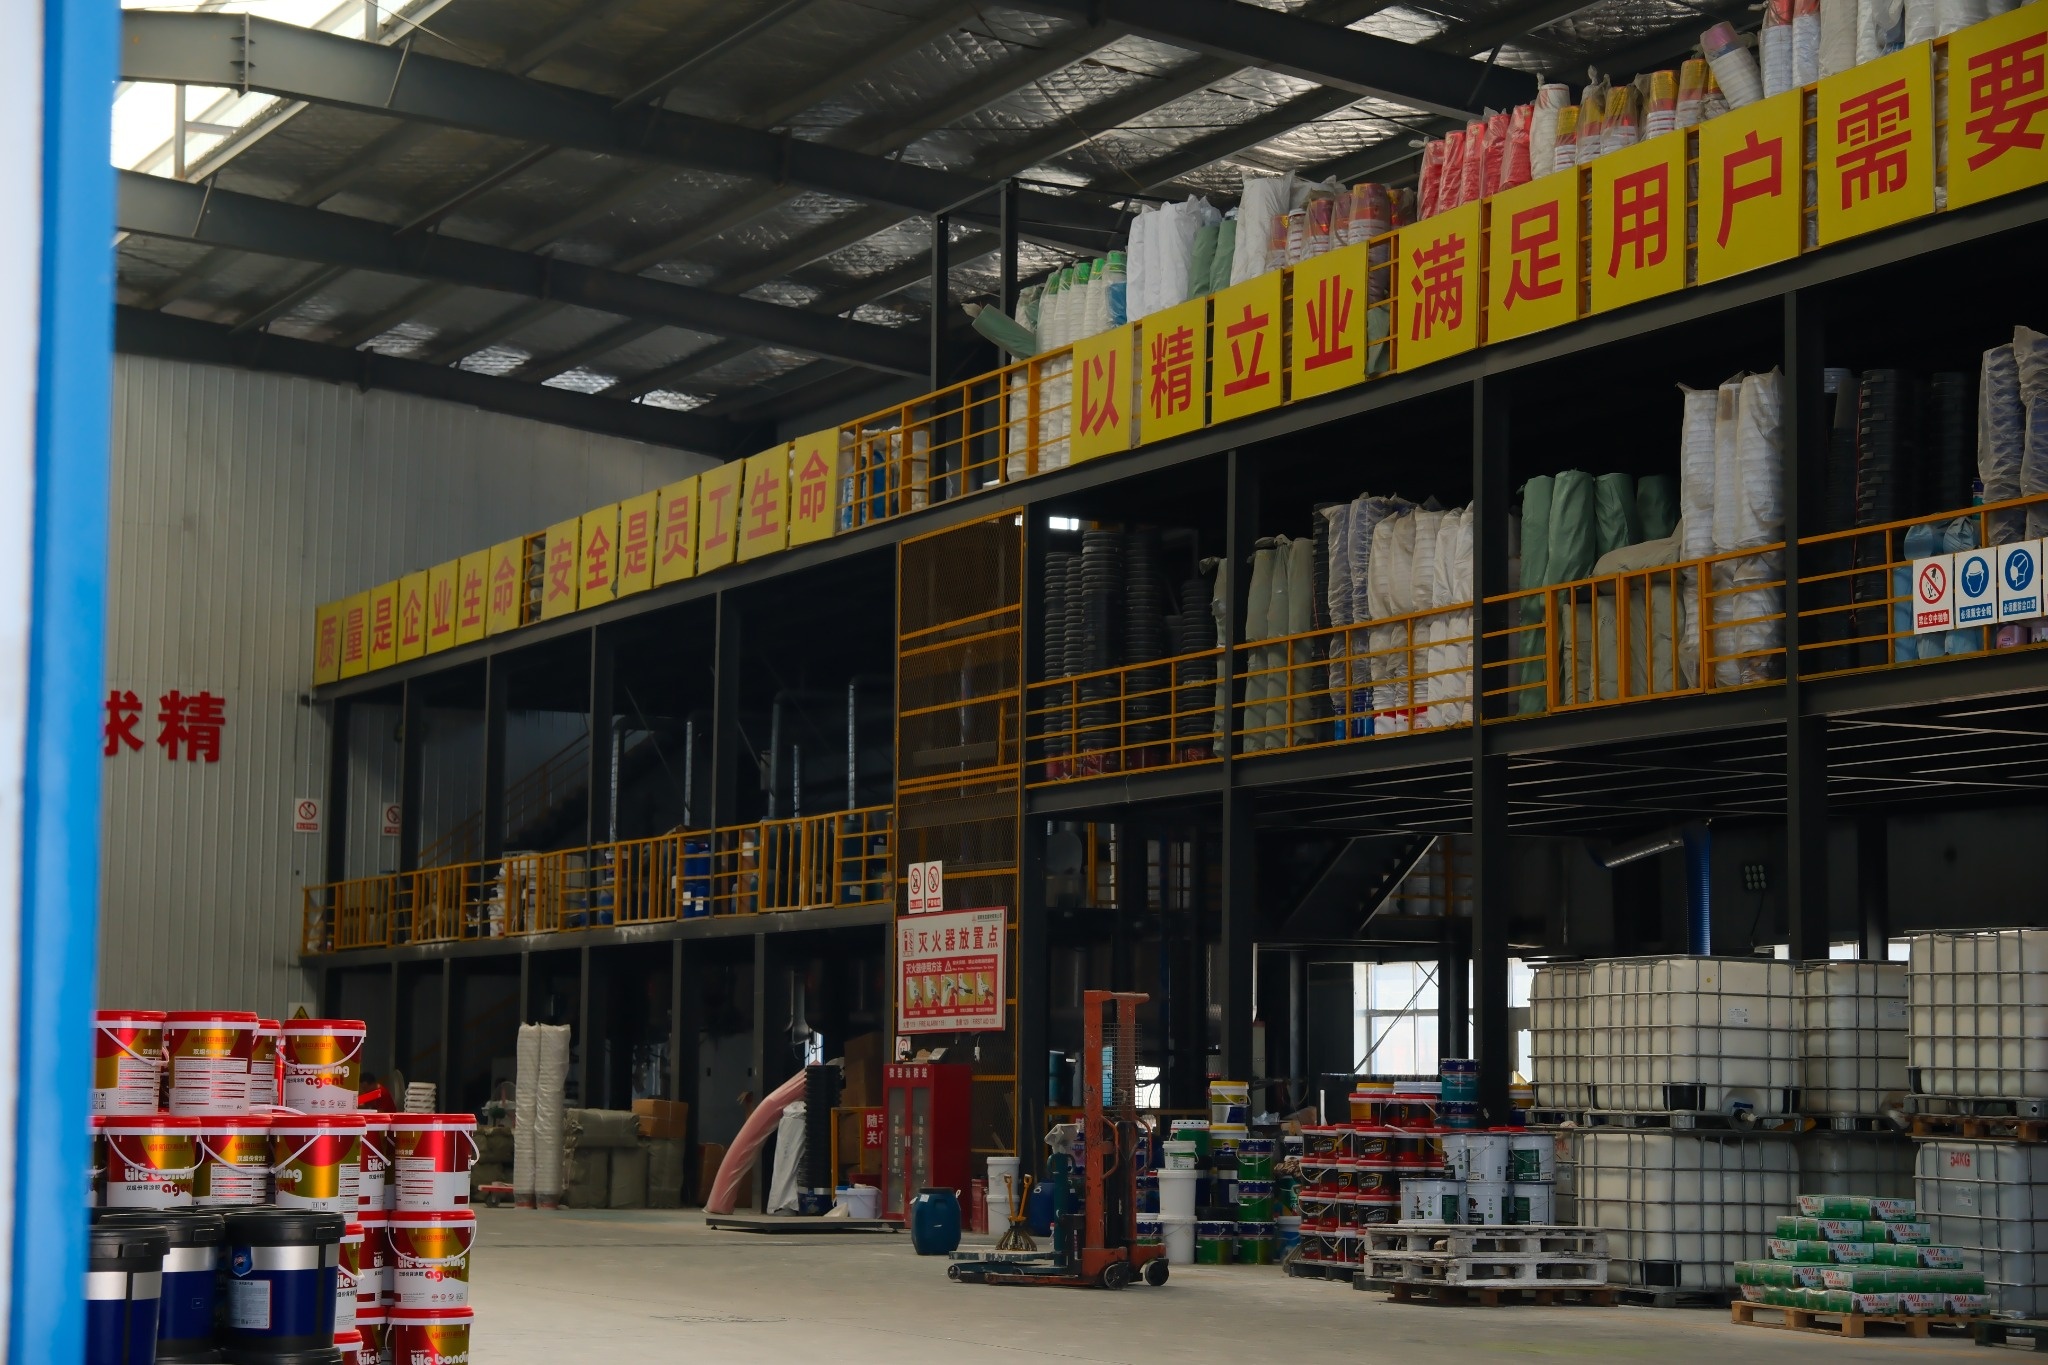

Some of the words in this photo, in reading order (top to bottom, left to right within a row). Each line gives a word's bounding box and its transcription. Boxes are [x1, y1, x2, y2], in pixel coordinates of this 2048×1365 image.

[1079, 275, 1354, 436] 以精立业
[1411, 32, 2048, 342] 满足用户需要
[318, 556, 515, 669] 质量是企业生命
[548, 449, 829, 601] 安全是员工生命
[1961, 608, 1991, 620] 必须戴安全帽
[104, 690, 225, 762] 求精
[918, 924, 998, 953] 灭火器放置点
[906, 961, 942, 974] 灭火器使用方法
[305, 1076, 344, 1088] agent
[1950, 1152, 1970, 1167] 54KG
[125, 1167, 149, 1181] tile
[1827, 1222, 1840, 1230] 901
[1895, 1224, 1907, 1232] 901
[1837, 1243, 1850, 1251] 901
[1926, 1247, 1939, 1256] 901
[425, 1269, 461, 1282] agent
[1802, 1268, 1815, 1276] 901
[1907, 1294, 1919, 1302] 901
[410, 1353, 433, 1365] tile
